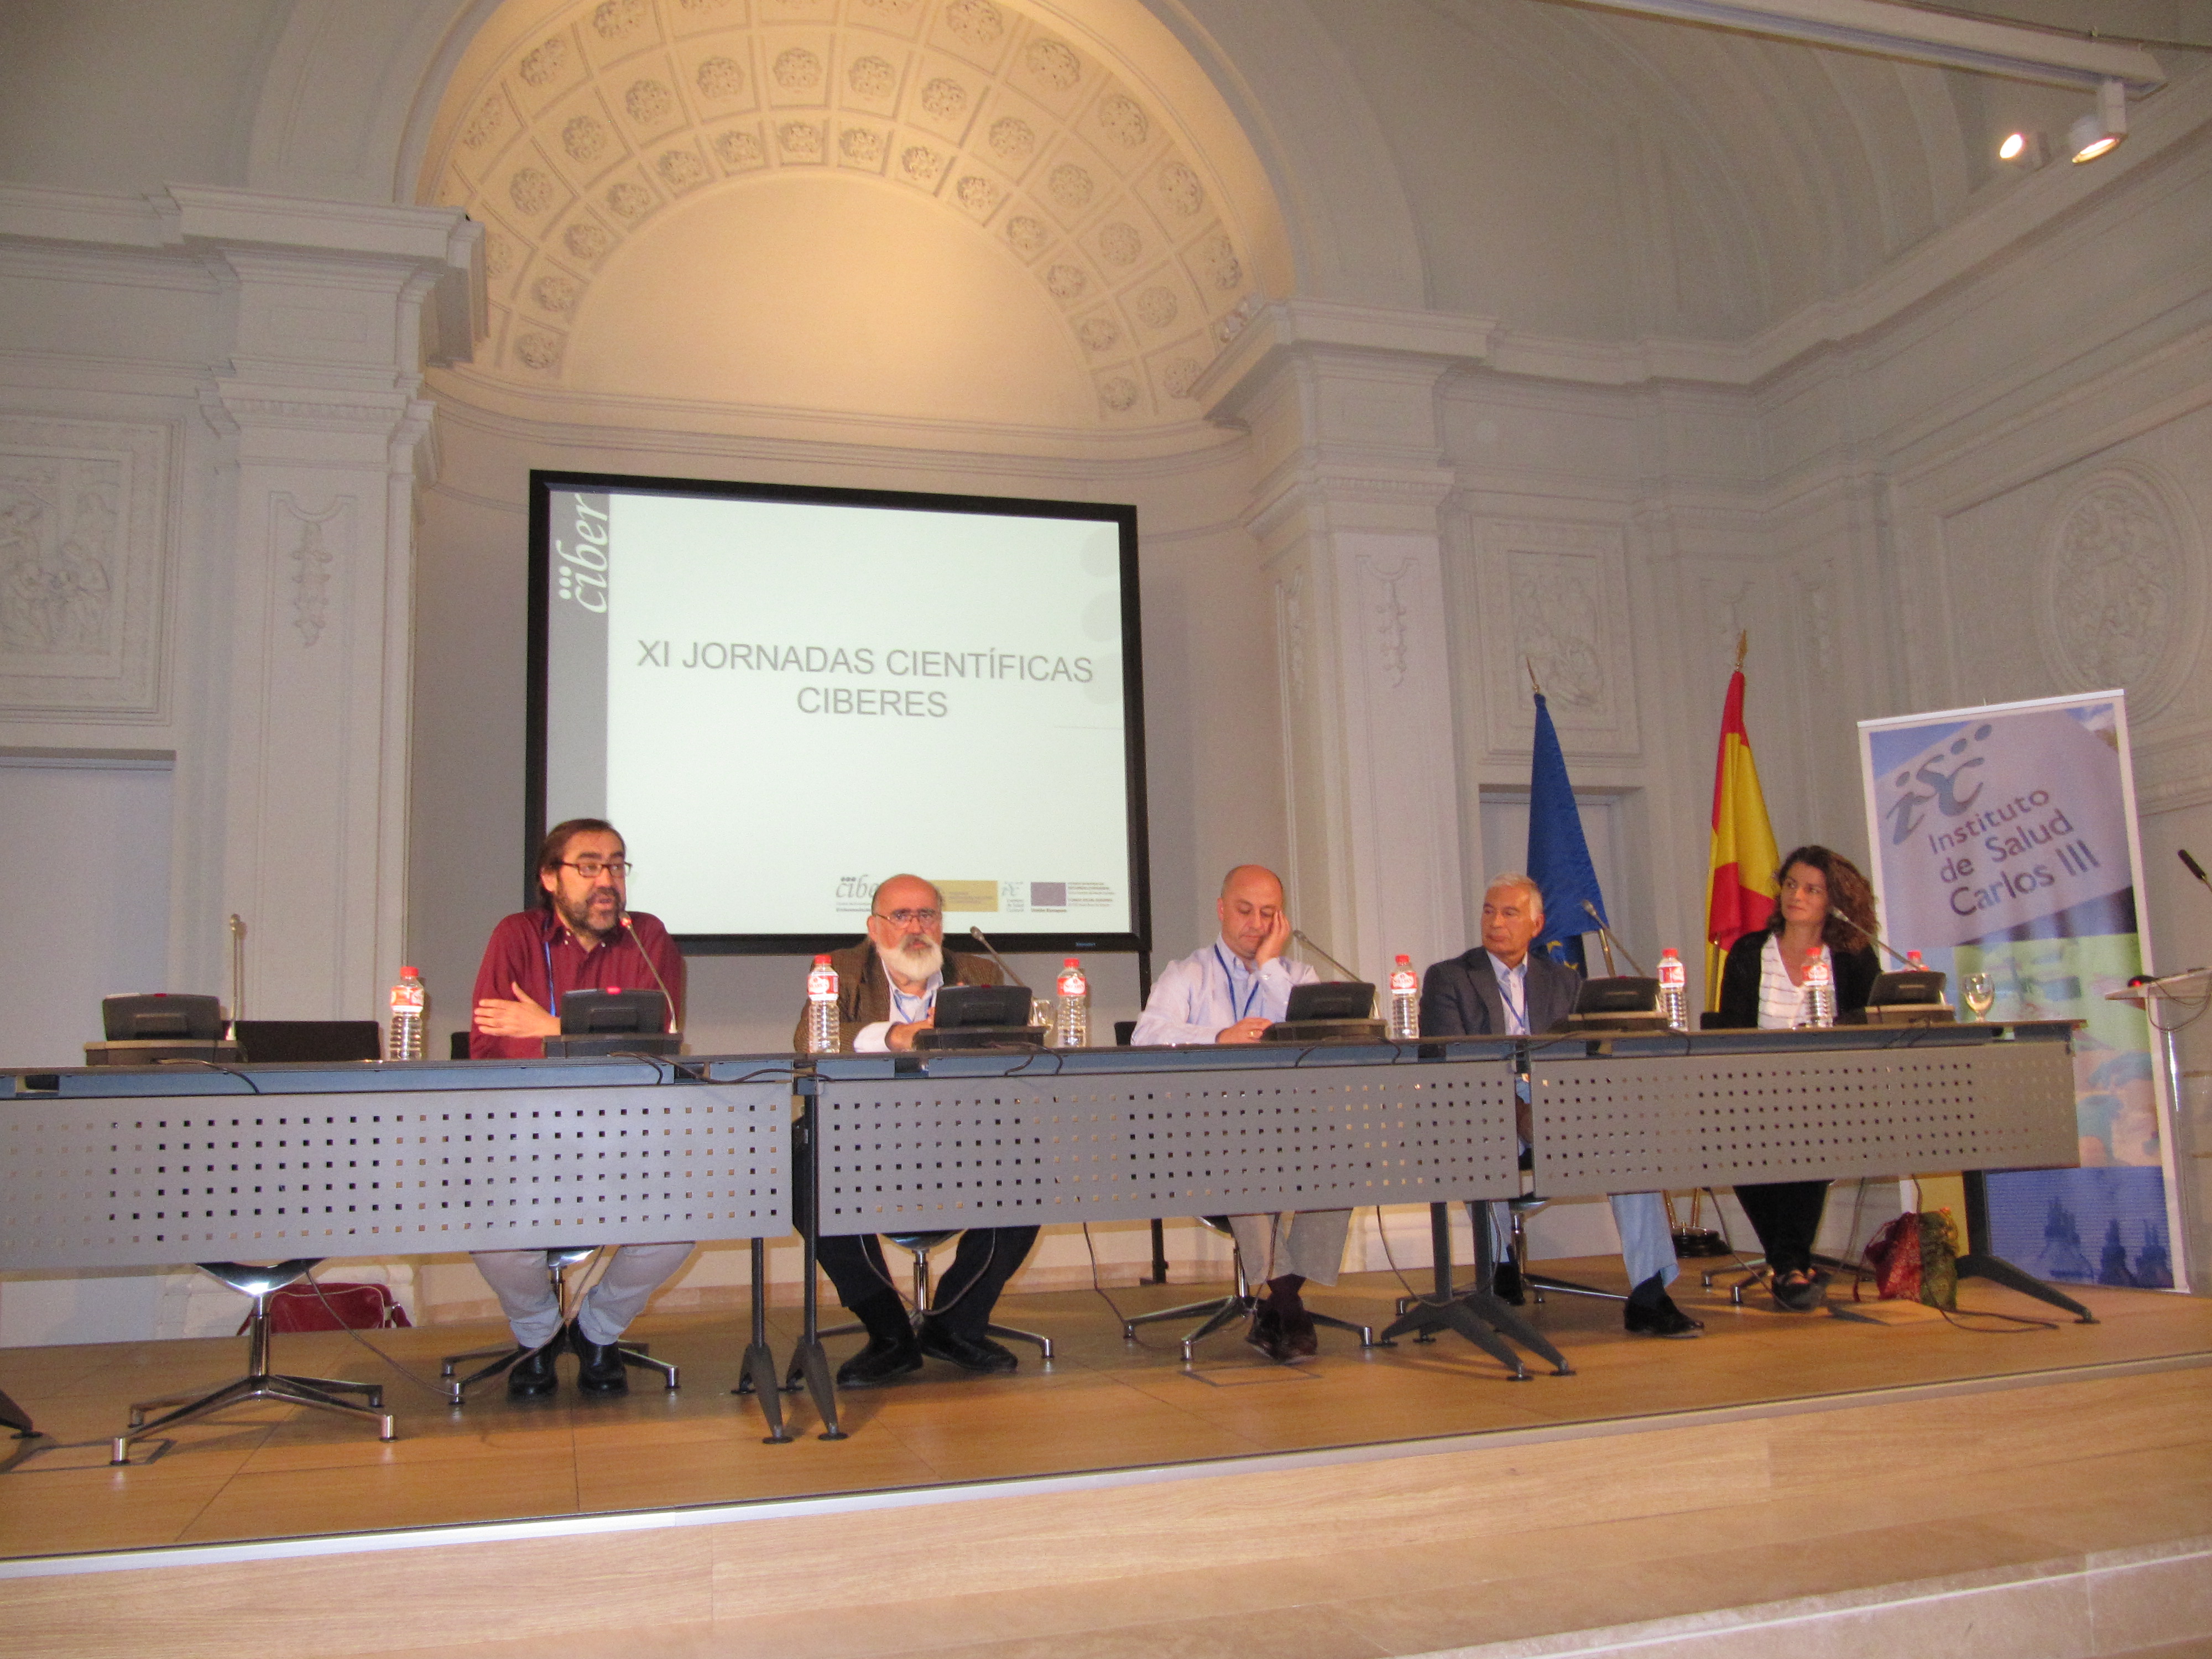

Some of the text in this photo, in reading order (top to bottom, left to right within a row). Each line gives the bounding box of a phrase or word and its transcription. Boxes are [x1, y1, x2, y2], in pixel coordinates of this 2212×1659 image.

[556, 493, 608, 613] ciber
[638, 641, 1093, 683] XI JORNADAS CIENTÍFICAS
[797, 687, 947, 717] CIBERES
[1928, 790, 2049, 854] Instituto
[1939, 809, 2074, 883] de Salud
[1950, 839, 2100, 916] Carlos III
